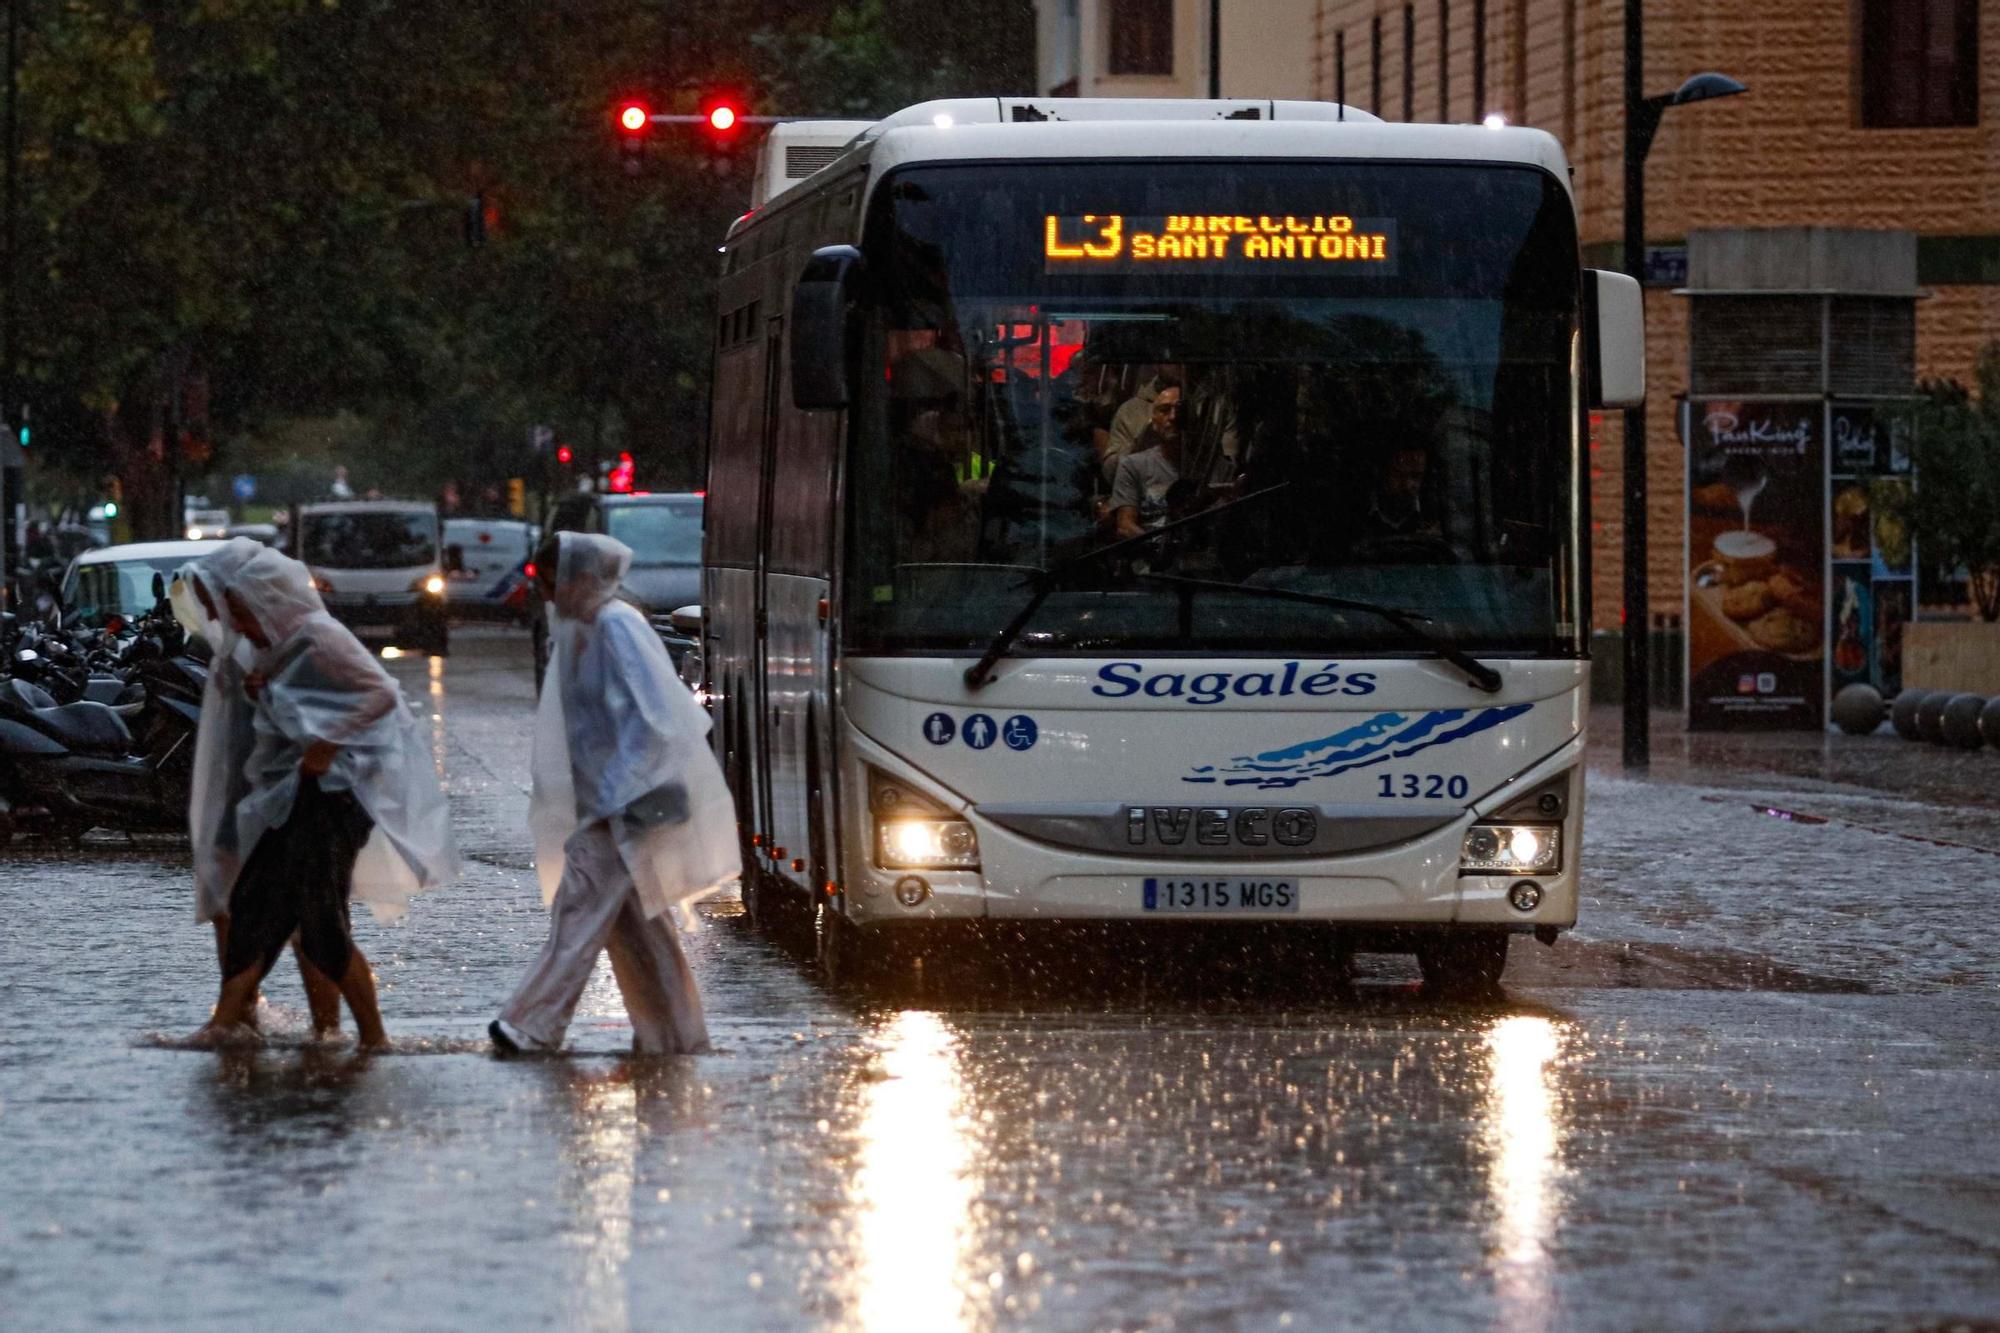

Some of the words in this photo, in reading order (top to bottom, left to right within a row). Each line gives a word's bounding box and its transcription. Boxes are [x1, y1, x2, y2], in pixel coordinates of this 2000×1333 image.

[1046, 215, 1122, 256] L3
[1132, 235, 1229, 257] SANT
[1245, 235, 1386, 258] ANTONI
[1091, 661, 1377, 705] Sagalés
[1377, 774, 1469, 800] 1320
[1128, 807, 1317, 847] IVECO
[1166, 882, 1230, 908] 1315
[1240, 882, 1291, 907] MGS
